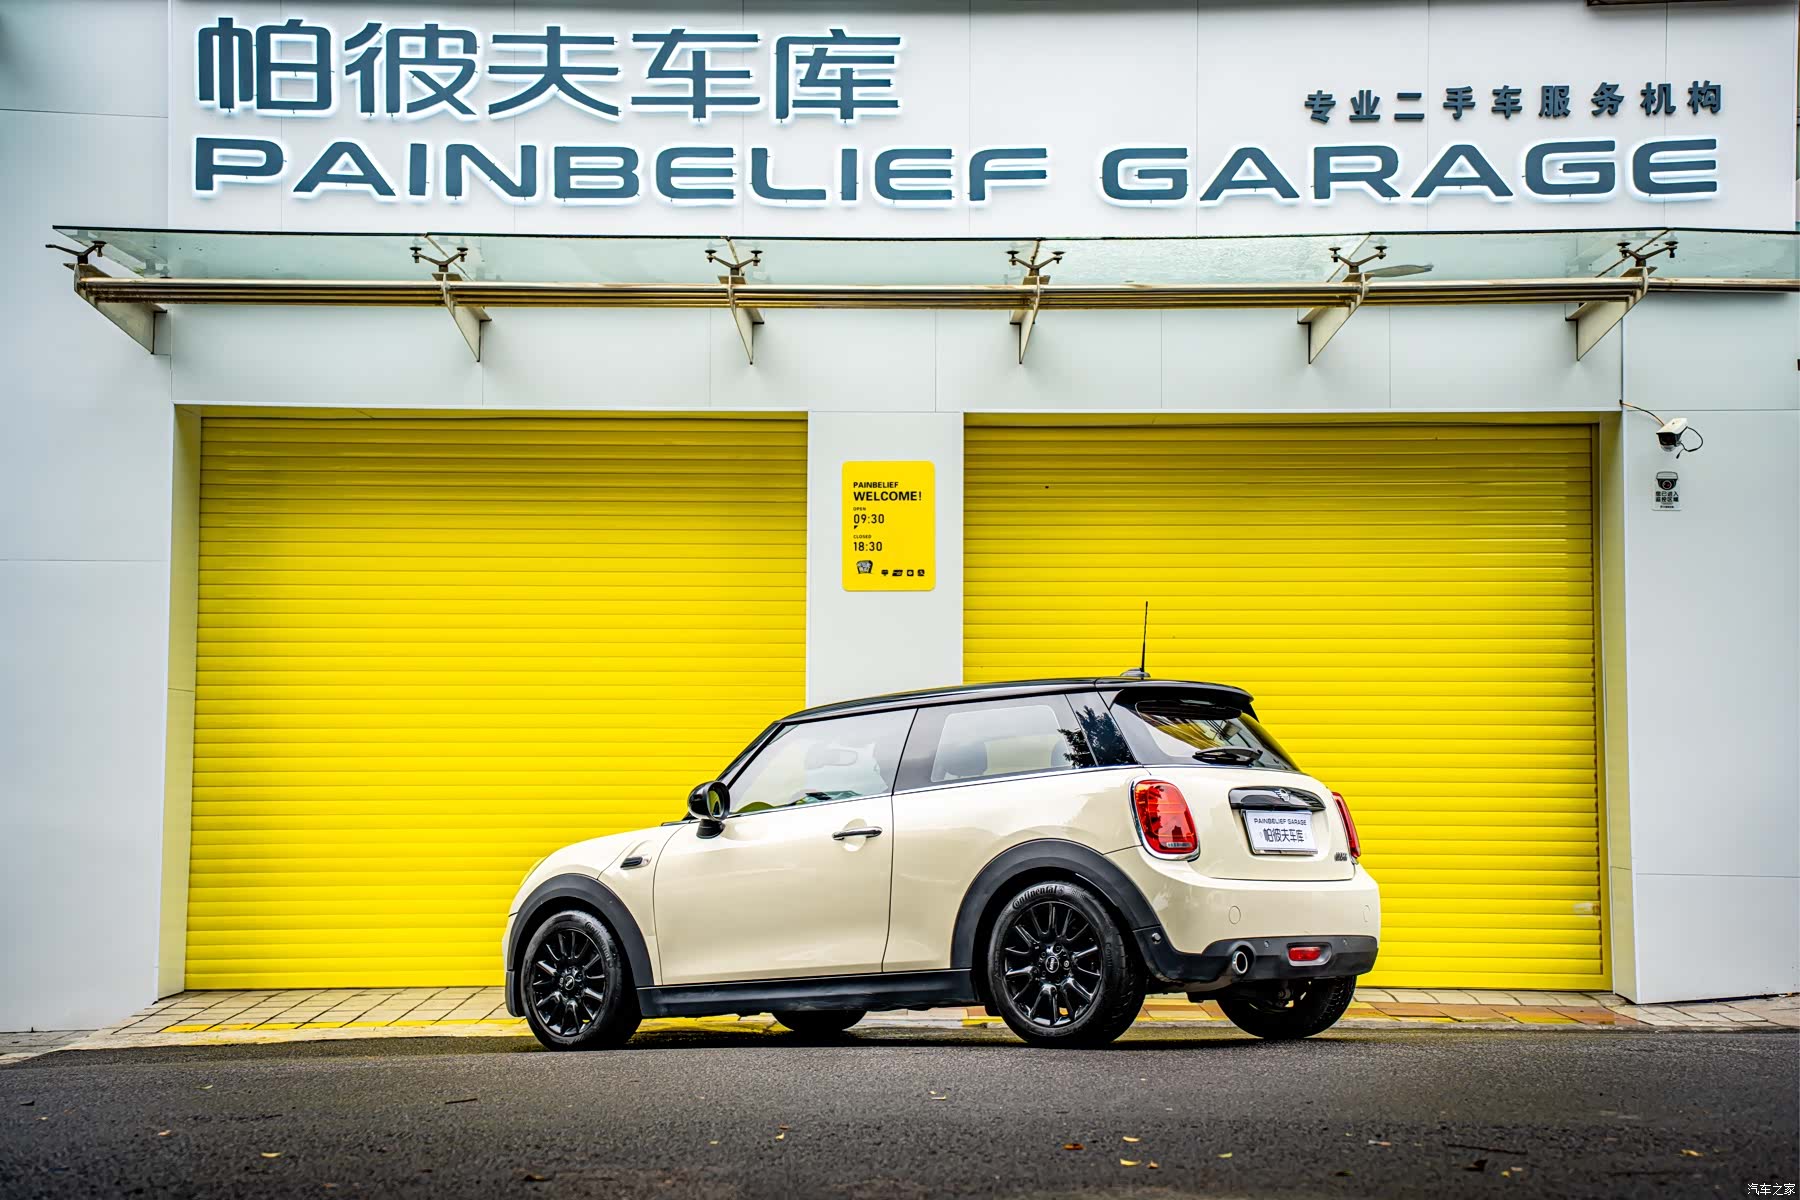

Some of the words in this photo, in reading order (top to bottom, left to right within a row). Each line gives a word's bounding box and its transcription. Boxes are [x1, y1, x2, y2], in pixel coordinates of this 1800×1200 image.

[198, 17, 902, 121] 帕彼夫车库
[1304, 80, 1722, 124] 专业二手车服务机构
[195, 137, 1048, 202] PAINBELIEF
[1101, 138, 1718, 202] GARAGE
[853, 481, 899, 489] PAINBELIEF
[853, 491, 922, 502] WELCOME!
[853, 513, 885, 524] 09:30
[853, 541, 883, 552] 18:30
[1254, 817, 1287, 825] PAINBELIEF
[1287, 818, 1307, 826] GARAGE
[1263, 827, 1305, 842] 帕彼夫车库
[1012, 885, 1058, 910] Continental
